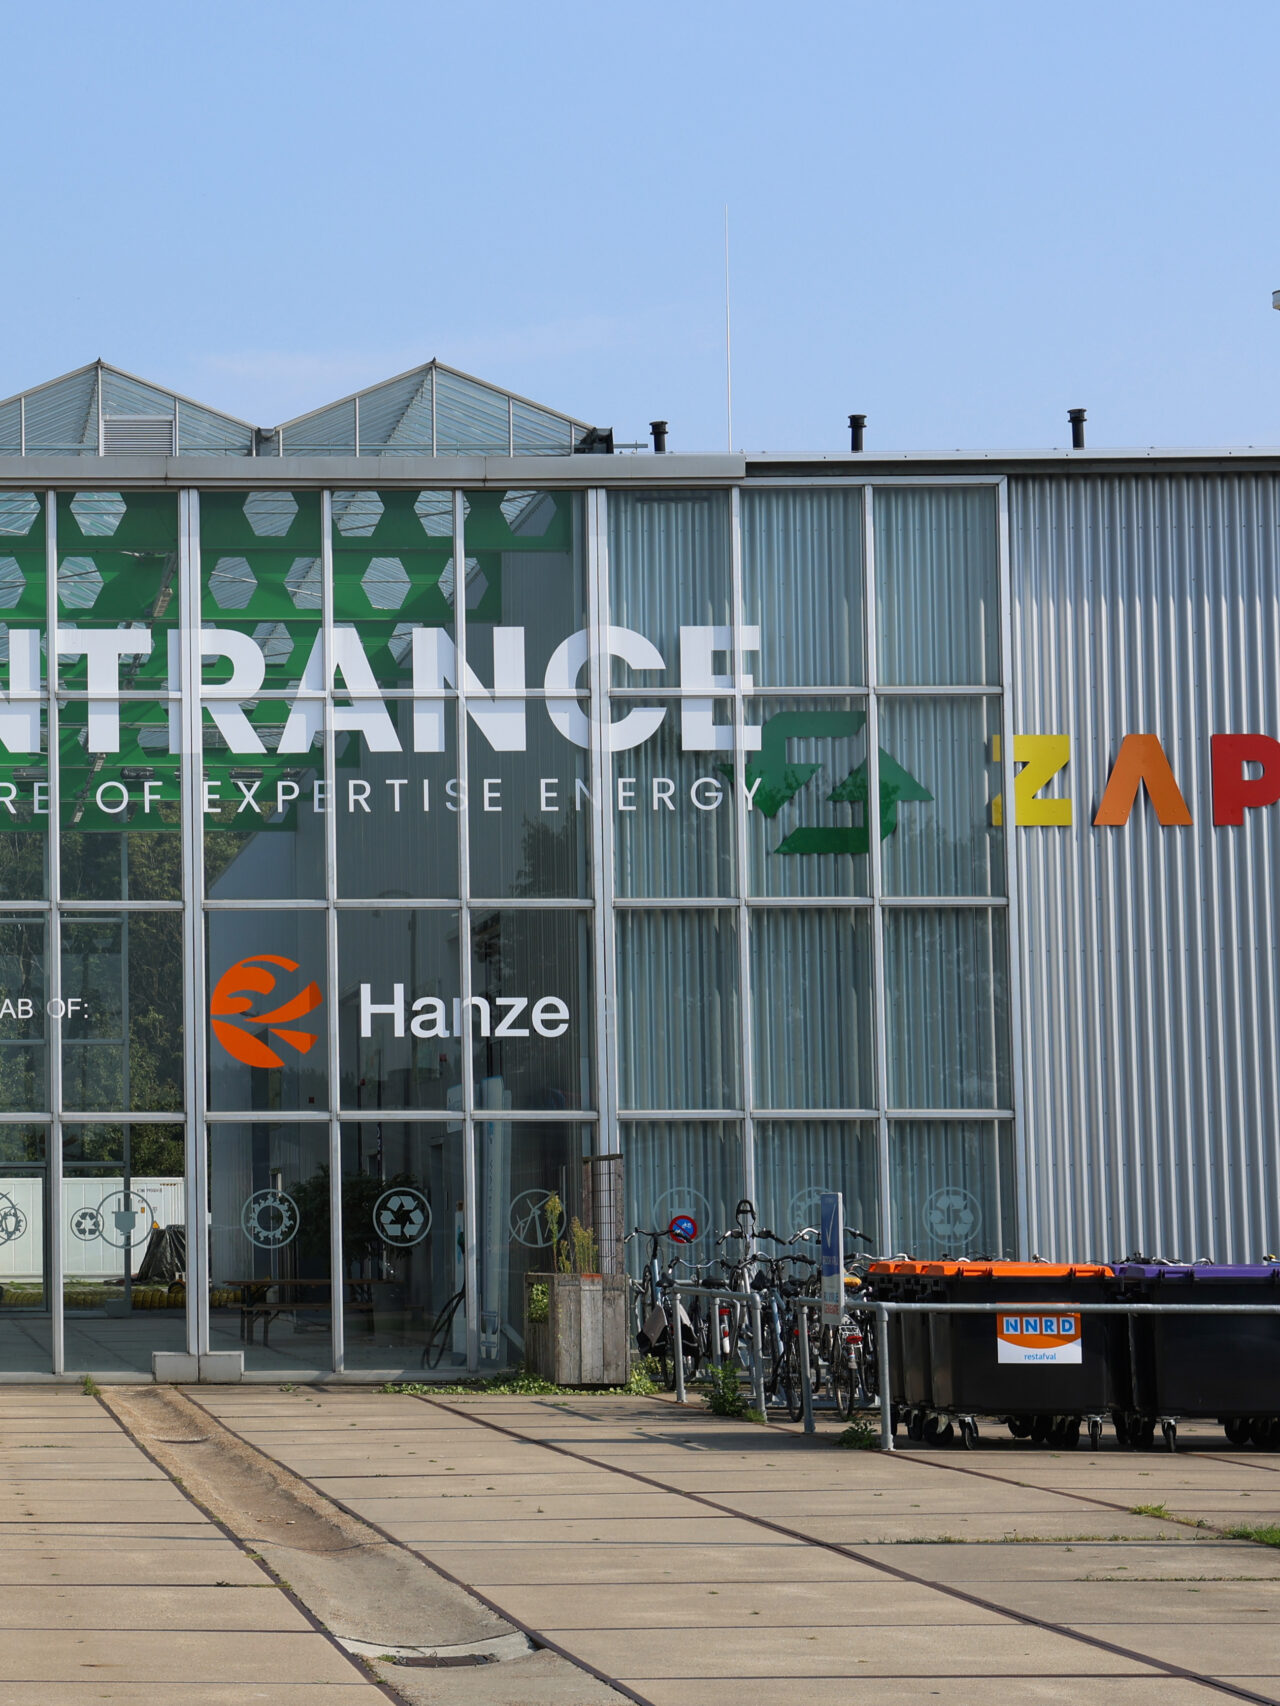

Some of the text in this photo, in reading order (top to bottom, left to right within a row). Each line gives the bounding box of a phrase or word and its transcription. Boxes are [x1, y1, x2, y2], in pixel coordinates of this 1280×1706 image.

[95, 780, 163, 814] OF
[204, 778, 504, 814] EXPERTISE
[540, 776, 763, 813] ENERGY
[992, 734, 1280, 826] ZAP
[46, 997, 90, 1020] OF:
[360, 982, 570, 1039] Hanze
[1004, 1318, 1074, 1333] NNRD
[1024, 1352, 1057, 1361] restafval
